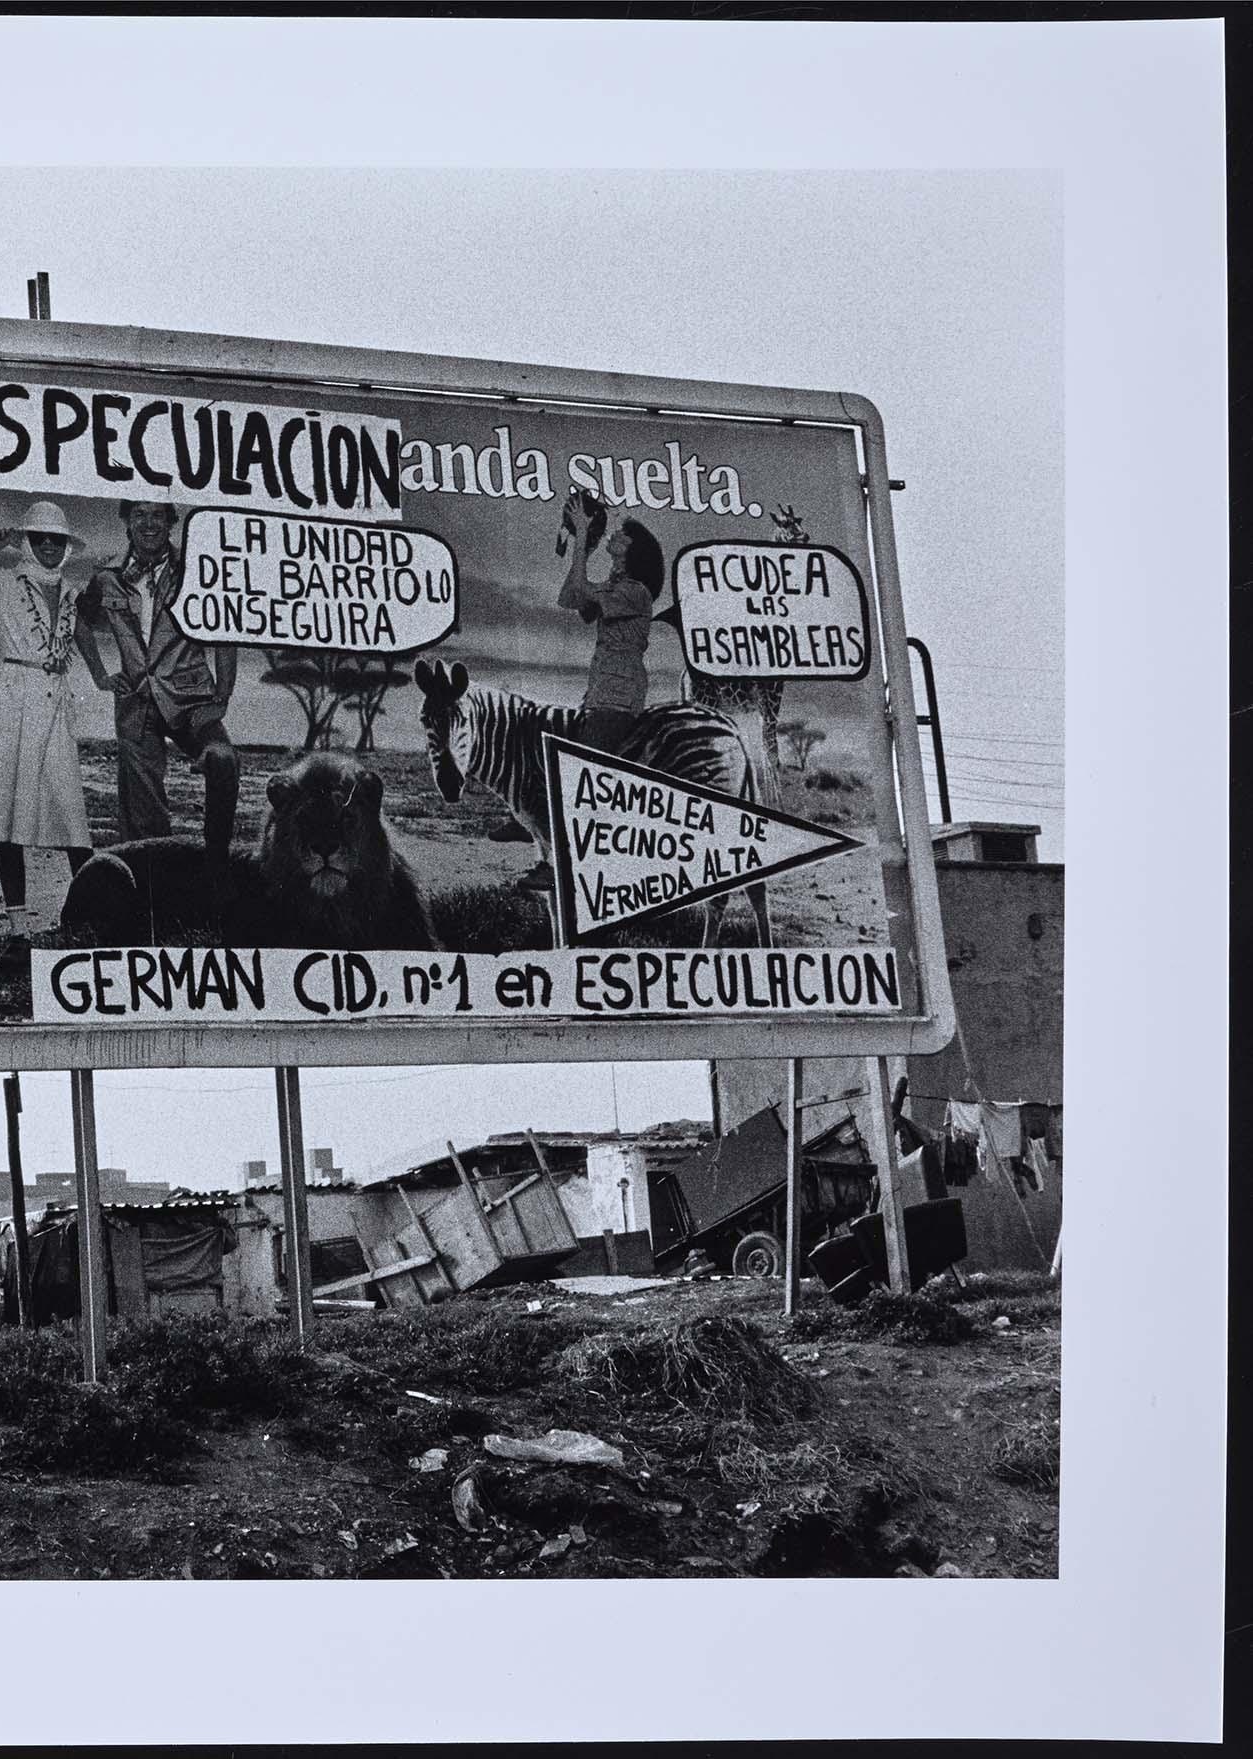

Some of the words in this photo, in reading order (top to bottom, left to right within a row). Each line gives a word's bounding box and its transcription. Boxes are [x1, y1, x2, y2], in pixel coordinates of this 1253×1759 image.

[400, 426, 554, 502] anda
[567, 441, 764, 519] suelta.
[219, 517, 267, 554] LA
[282, 522, 413, 567] UNIDAD
[198, 554, 266, 596] DEL
[280, 560, 421, 605] BARRIO
[183, 593, 396, 645] CONSEGUIRA
[746, 597, 789, 617] LAS
[691, 625, 864, 668] ASAMBLEAS
[575, 767, 715, 834] ASAMBLEA
[739, 812, 769, 842] DE
[573, 818, 695, 862] VECINOS
[578, 866, 694, 921] VERNEDA
[703, 845, 762, 884] ALTA
[50, 948, 265, 1015] GERMAN
[496, 963, 553, 1007] en
[575, 952, 900, 1010] ESPECULACION
